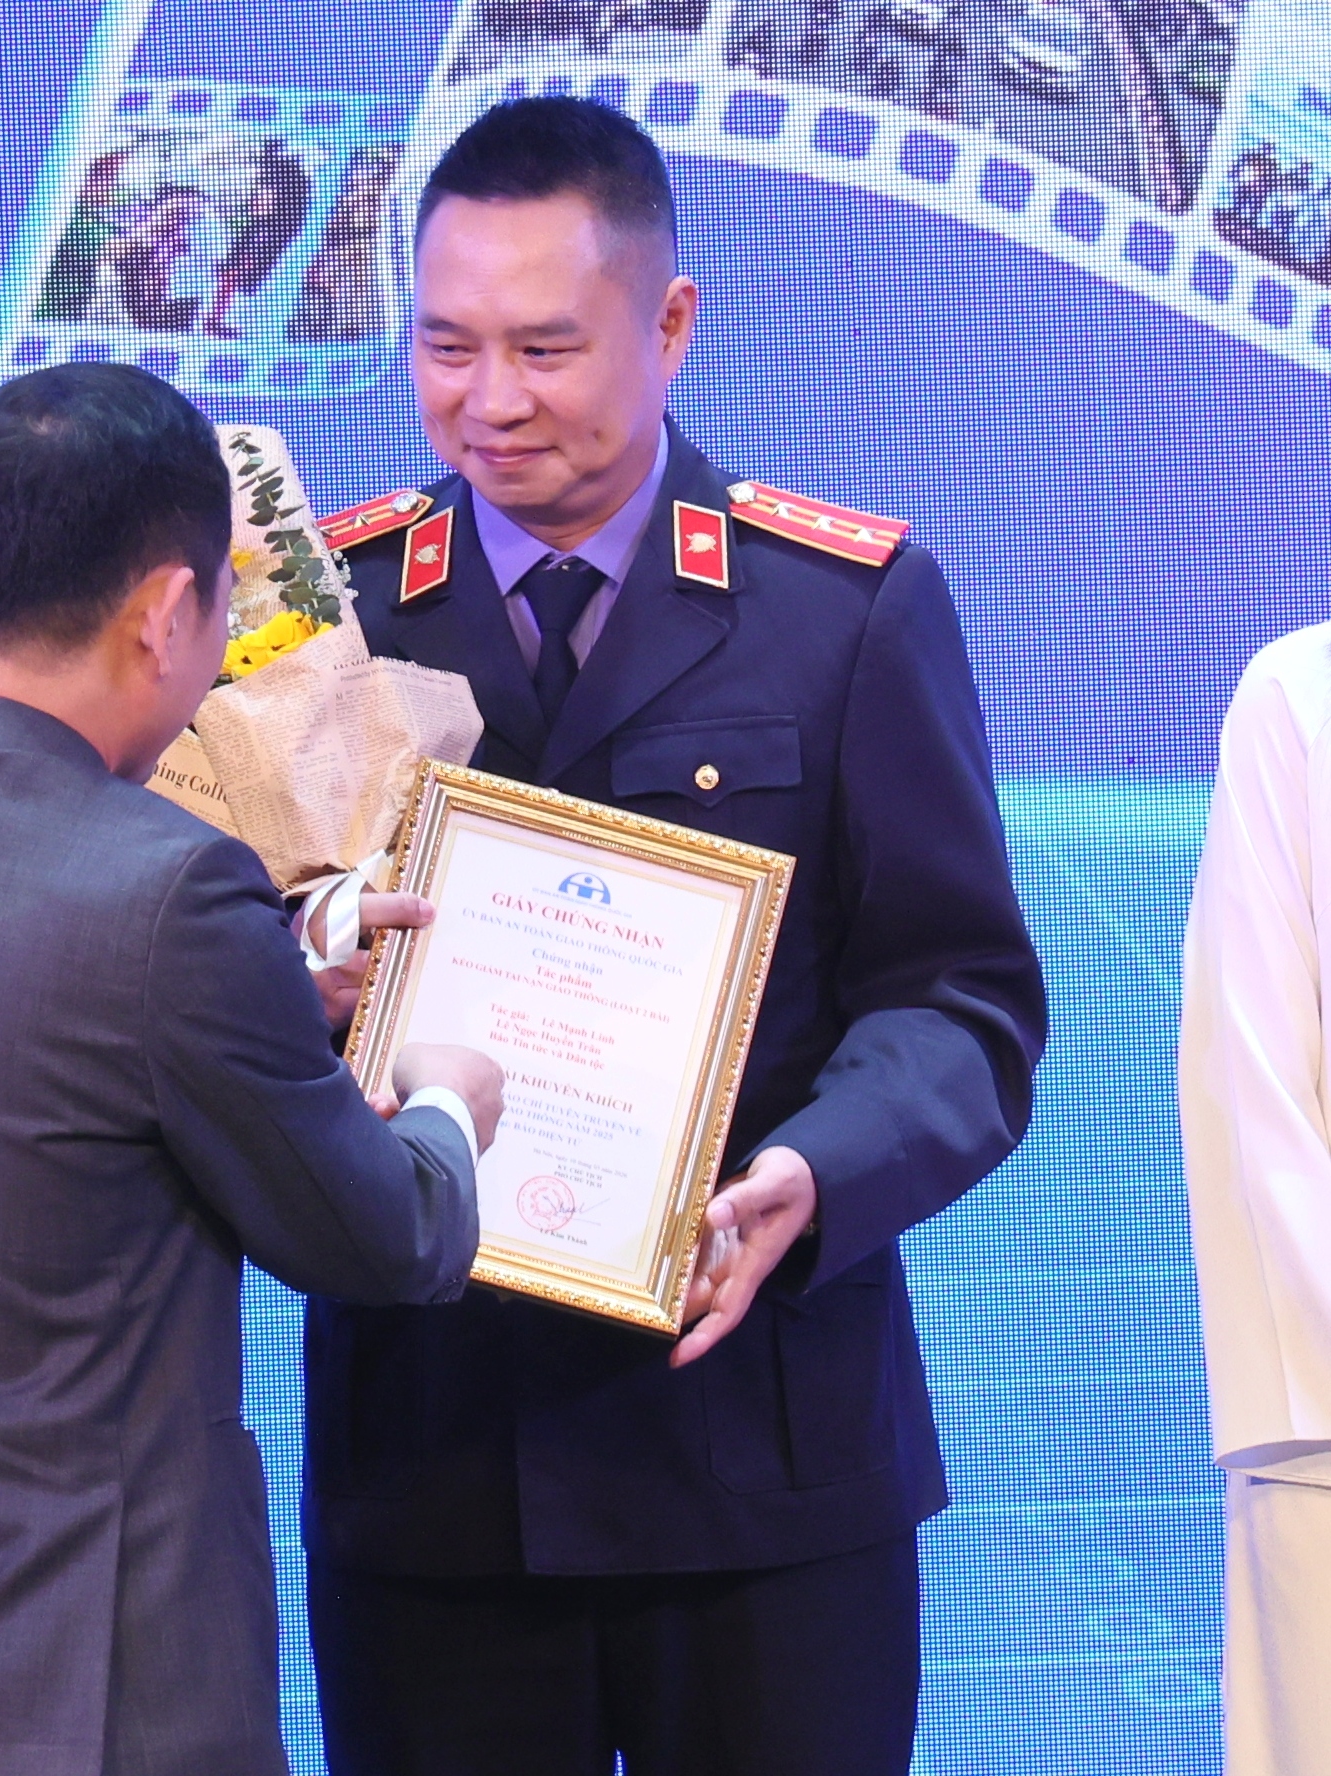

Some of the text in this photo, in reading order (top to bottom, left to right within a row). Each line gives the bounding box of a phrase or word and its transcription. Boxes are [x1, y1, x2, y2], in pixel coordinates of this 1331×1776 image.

[491, 890, 664, 951] GIẤY CHỨNG NHẬN
[480, 912, 502, 925] BAN
[506, 920, 520, 930] AN
[554, 934, 584, 948] GIAO
[588, 941, 626, 960] THÔNG
[662, 964, 683, 976] GIA
[531, 947, 604, 976] Chứng nhận
[535, 964, 593, 990] Tác phẩm
[544, 982, 571, 996] GIAO
[490, 1003, 508, 1016] Tác
[542, 1016, 556, 1028] Lê
[558, 1022, 588, 1038] Mạnh
[590, 1030, 616, 1045] Linh
[496, 1018, 510, 1030] Lê
[512, 1022, 538, 1038] Ngọc
[512, 1036, 530, 1049] Tin
[550, 1048, 564, 1058] và
[566, 1052, 586, 1065] Dân
[584, 1090, 633, 1114] KHÍCH
[592, 1128, 614, 1140] 2025
